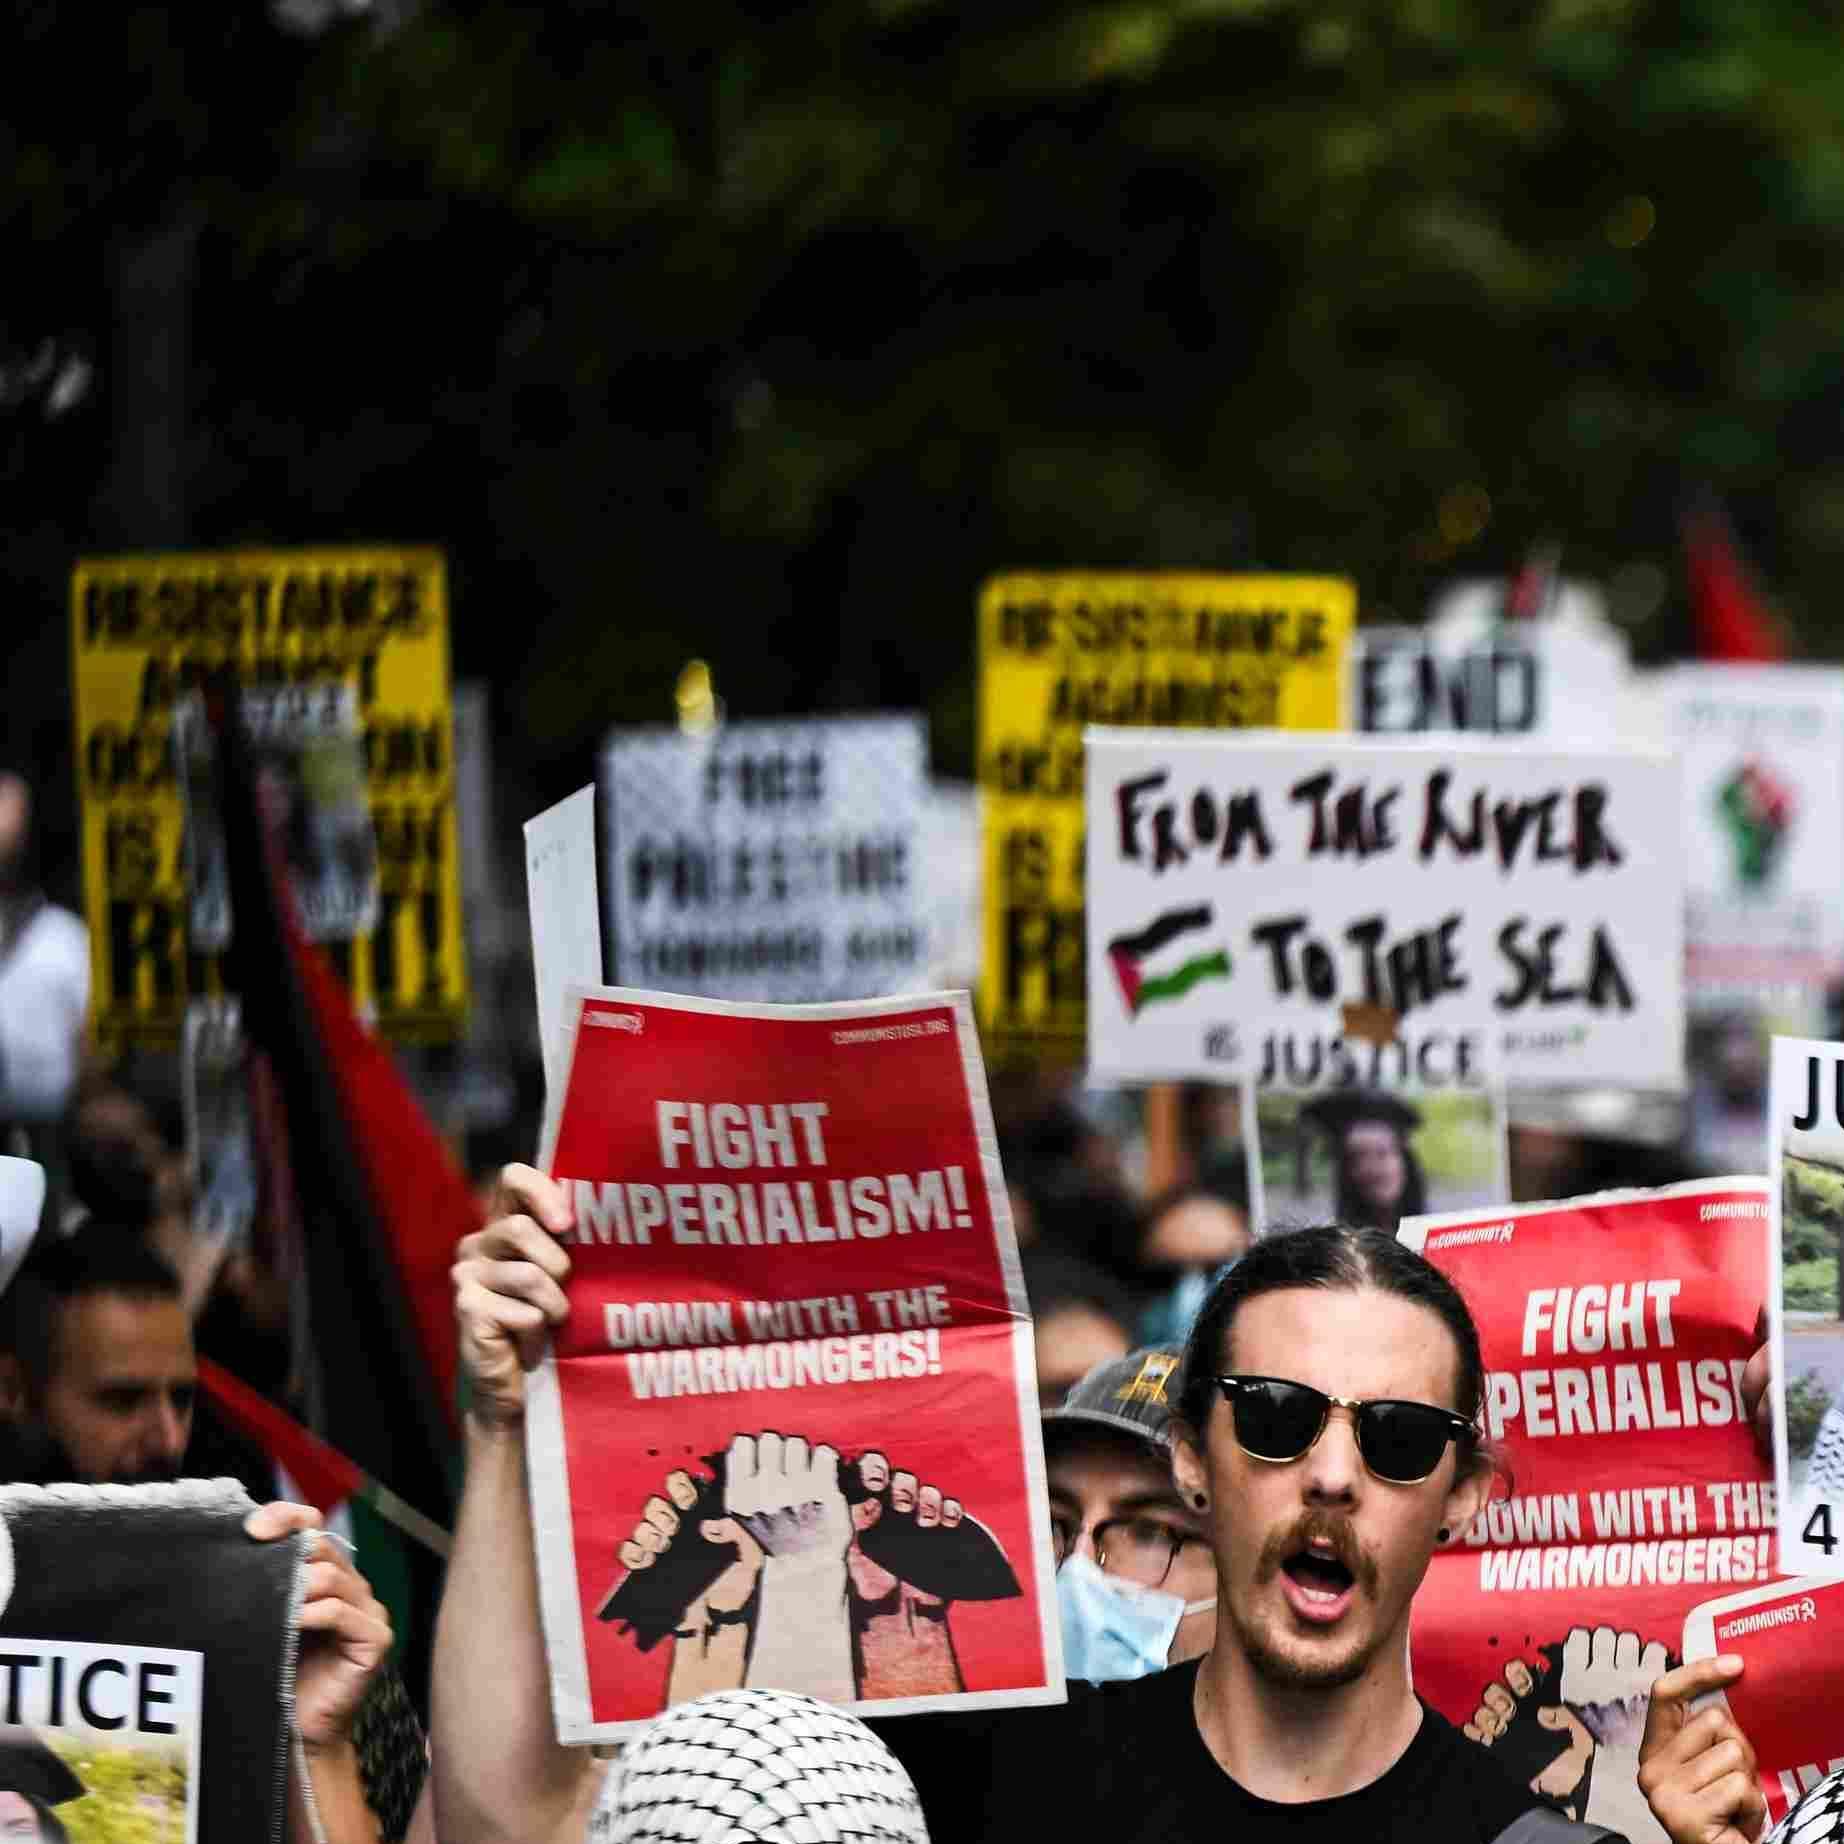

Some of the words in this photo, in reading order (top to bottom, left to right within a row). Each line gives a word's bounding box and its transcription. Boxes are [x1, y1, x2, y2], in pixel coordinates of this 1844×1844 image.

[1115, 766, 1272, 874] FROM
[1290, 765, 1401, 858] THE
[1418, 766, 1623, 871] RIVER
[1251, 916, 1336, 1002] TO
[1347, 912, 1469, 1015] THE
[1496, 915, 1635, 1014] SEA
[656, 1100, 829, 1169] FIGHT
[604, 1301, 736, 1348] DOWN
[745, 1296, 859, 1342] WITH
[869, 1285, 953, 1329] THE
[1522, 1279, 1681, 1357] FIGHT
[627, 1329, 943, 1399] WARMONGERS!
[1589, 1486, 1696, 1538] WITH
[1802, 1504, 1839, 1556] 4
[1481, 1535, 1769, 1591] WARMONGERS!
[1729, 1607, 1802, 1638] COMMUNIST
